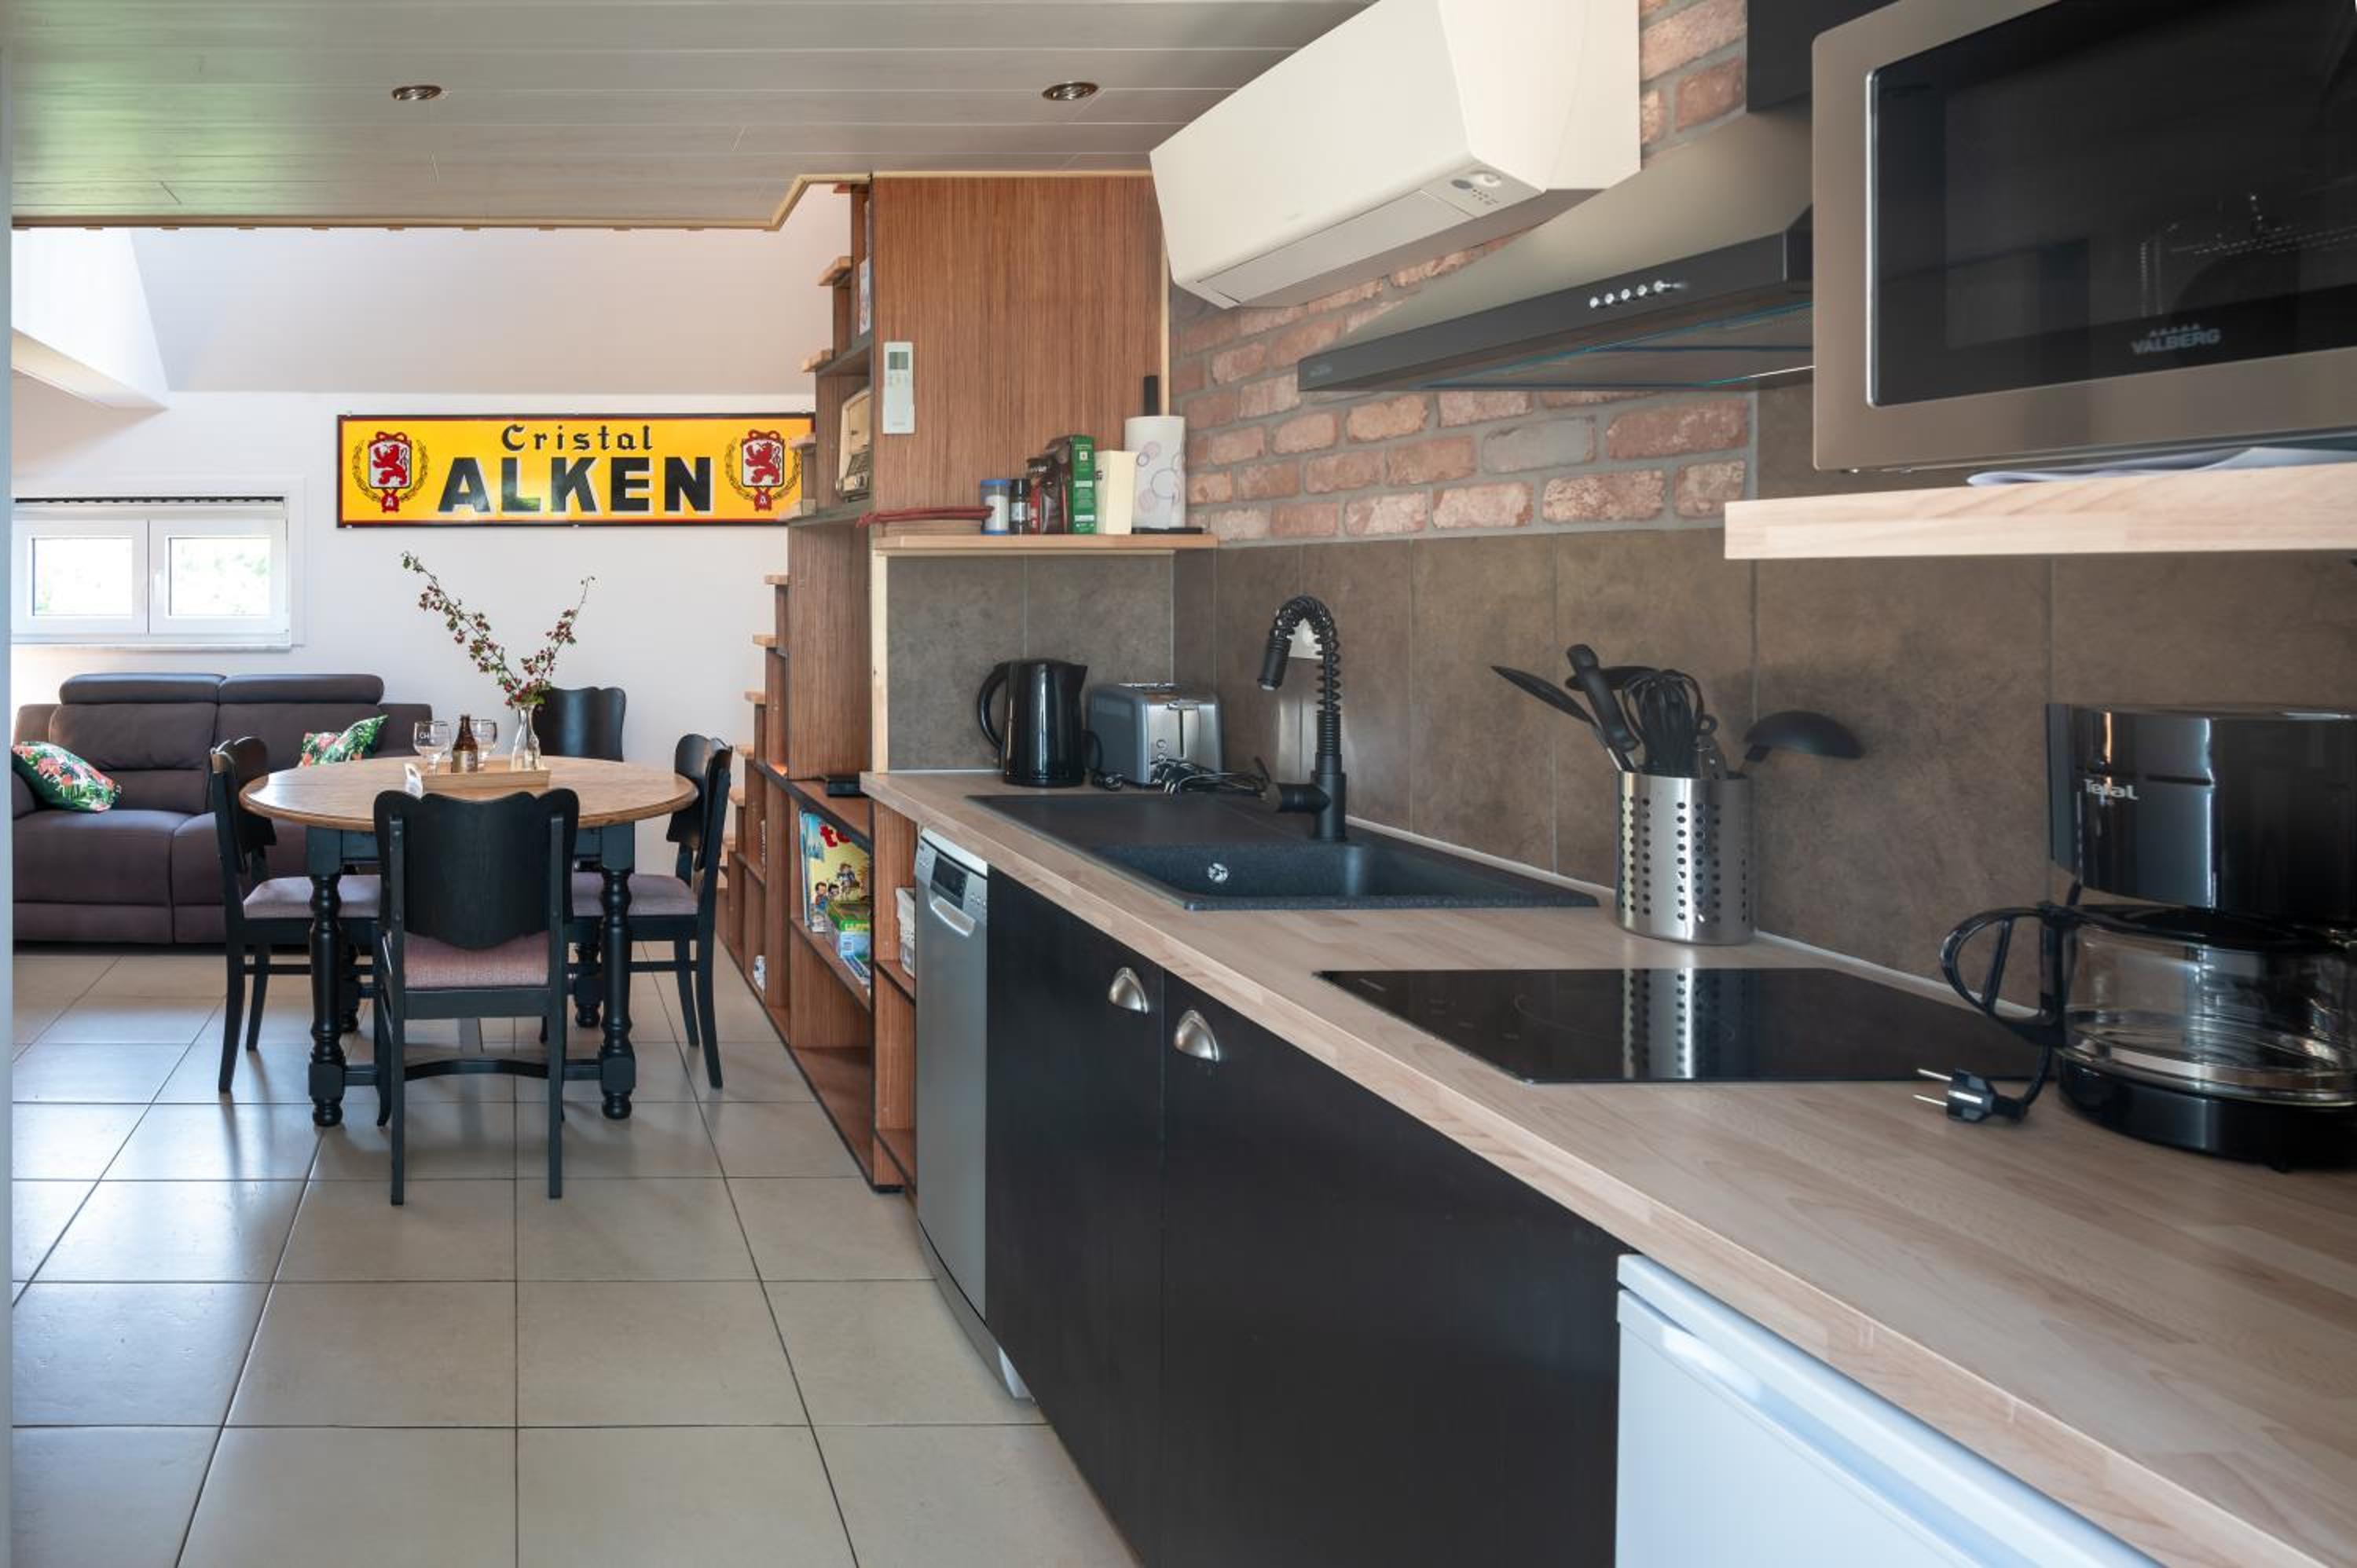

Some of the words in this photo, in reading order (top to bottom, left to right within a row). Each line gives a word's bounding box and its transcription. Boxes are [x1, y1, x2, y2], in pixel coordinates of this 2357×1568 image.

[2130, 328, 2221, 354] VALBERG
[500, 425, 654, 452] Cristal
[437, 456, 713, 515] ALKEN
